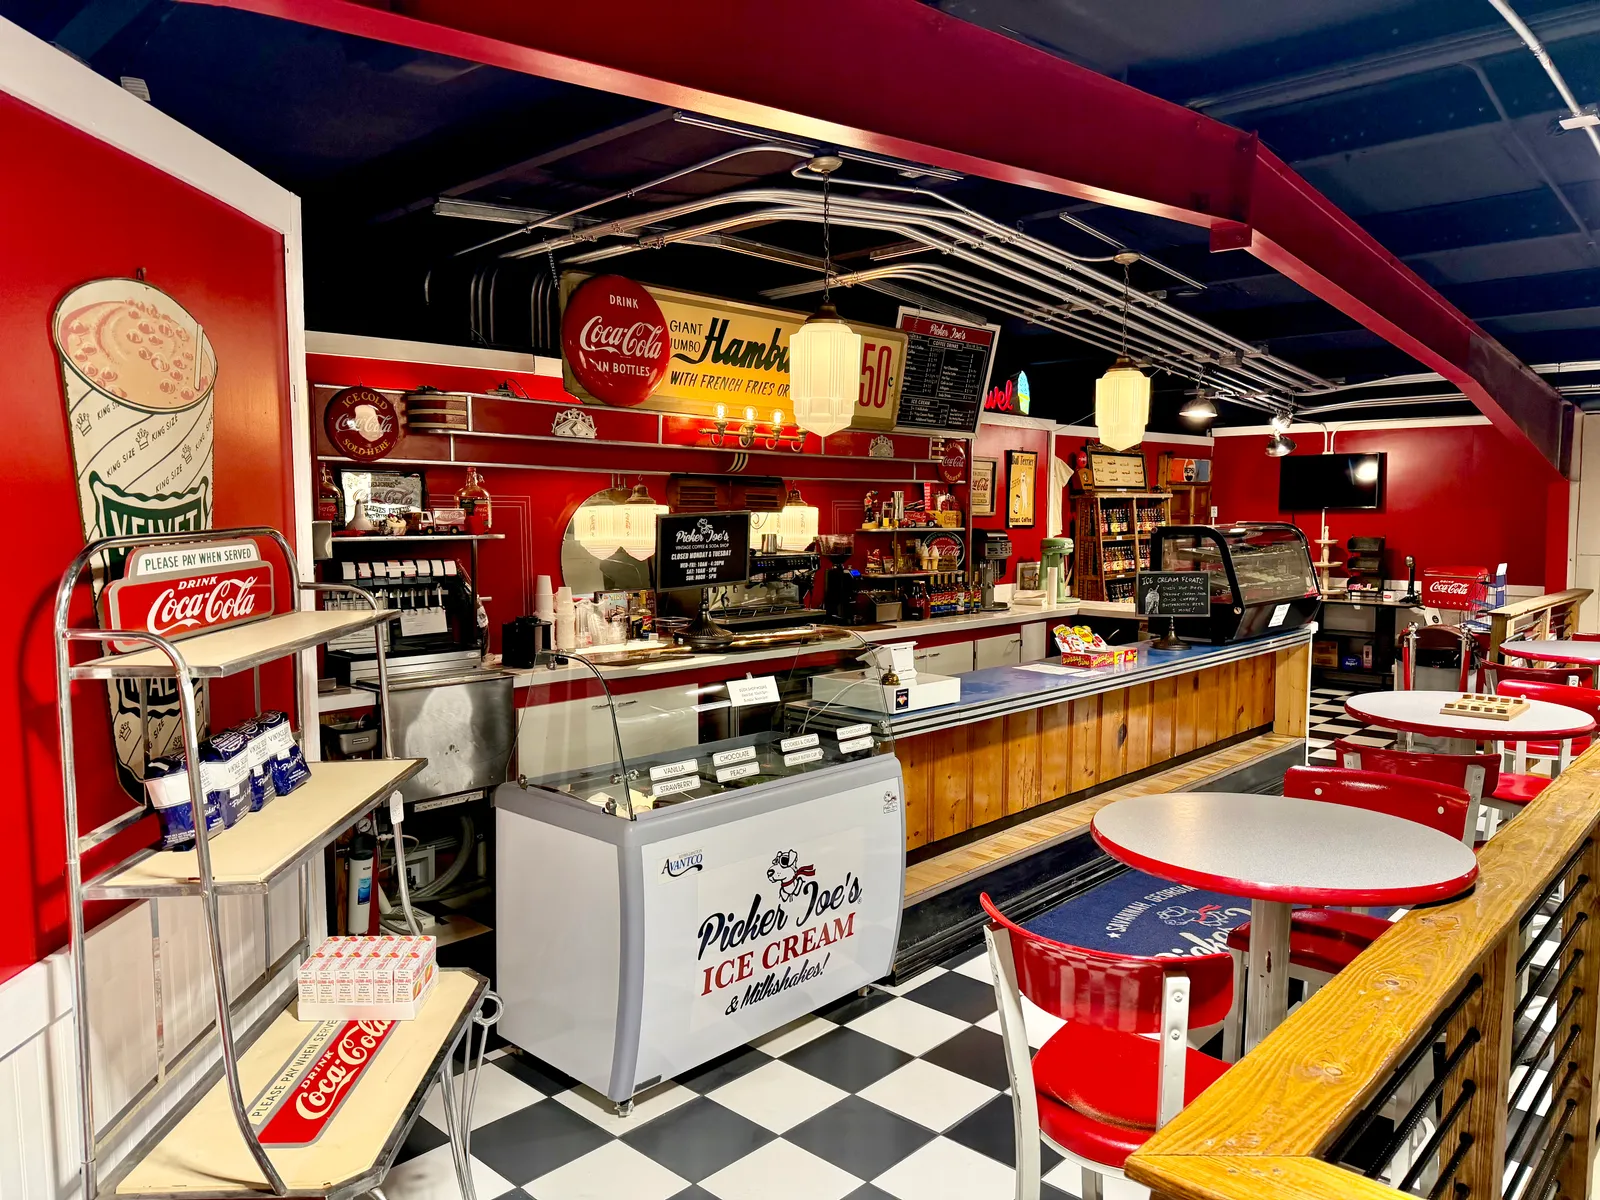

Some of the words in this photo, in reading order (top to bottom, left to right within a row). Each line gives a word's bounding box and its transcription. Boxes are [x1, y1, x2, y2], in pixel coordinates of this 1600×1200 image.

[609, 294, 639, 309] DRINK
[580, 315, 664, 359] Coca-Cola
[669, 319, 703, 335] GIANT
[930, 323, 948, 337] Picker
[598, 361, 609, 372] IN
[613, 362, 650, 377] BOTTLES
[670, 370, 698, 387] WITH
[700, 374, 744, 392] FRENCH
[745, 379, 776, 396] FRIES
[342, 393, 361, 409] ICE
[361, 391, 388, 411] COLD
[97, 404, 111, 420] KING
[151, 425, 166, 442] KING
[166, 413, 179, 430] SIZE
[335, 413, 393, 433] Coca-Cola
[195, 433, 205, 451] KING
[342, 438, 366, 456] SOLD
[367, 440, 391, 456] HERE
[106, 461, 121, 478] KING
[122, 447, 136, 463] SIZE
[155, 478, 170, 493] KING
[171, 464, 183, 480] SIZE
[676, 529, 704, 543] Picker
[706, 530, 729, 543] Joe's
[145, 555, 179, 571] PLEASE
[182, 553, 197, 567] PAY
[199, 550, 222, 564] WHEN
[225, 547, 252, 561] SERVED
[178, 576, 218, 590] DRINK
[1141, 576, 1153, 585] ICE
[1181, 576, 1204, 585] FLOATS
[1430, 581, 1470, 595] Coca-Cola
[147, 576, 258, 635] Coca-Cola
[154, 719, 164, 739] SIZE
[719, 750, 750, 763] CHOCOLATE
[664, 764, 685, 774] VANILLA
[730, 767, 747, 777] PEACH
[660, 780, 693, 793] STRAWBERRY
[1144, 884, 1198, 904] GEORGIA
[697, 894, 789, 961] Picker
[796, 872, 862, 928] Joe's
[701, 951, 755, 996] ICE
[762, 912, 856, 970] CREAM
[725, 996, 738, 1016] &
[740, 952, 830, 1010] Milkshakes!
[252, 1085, 286, 1117] PLEASE
[281, 1067, 299, 1082] PAY
[295, 1045, 316, 1068] WHEN
[313, 1019, 338, 1041] SERVE
[295, 1020, 393, 1120] Coca-Cola
[302, 1050, 334, 1089] DRINK
